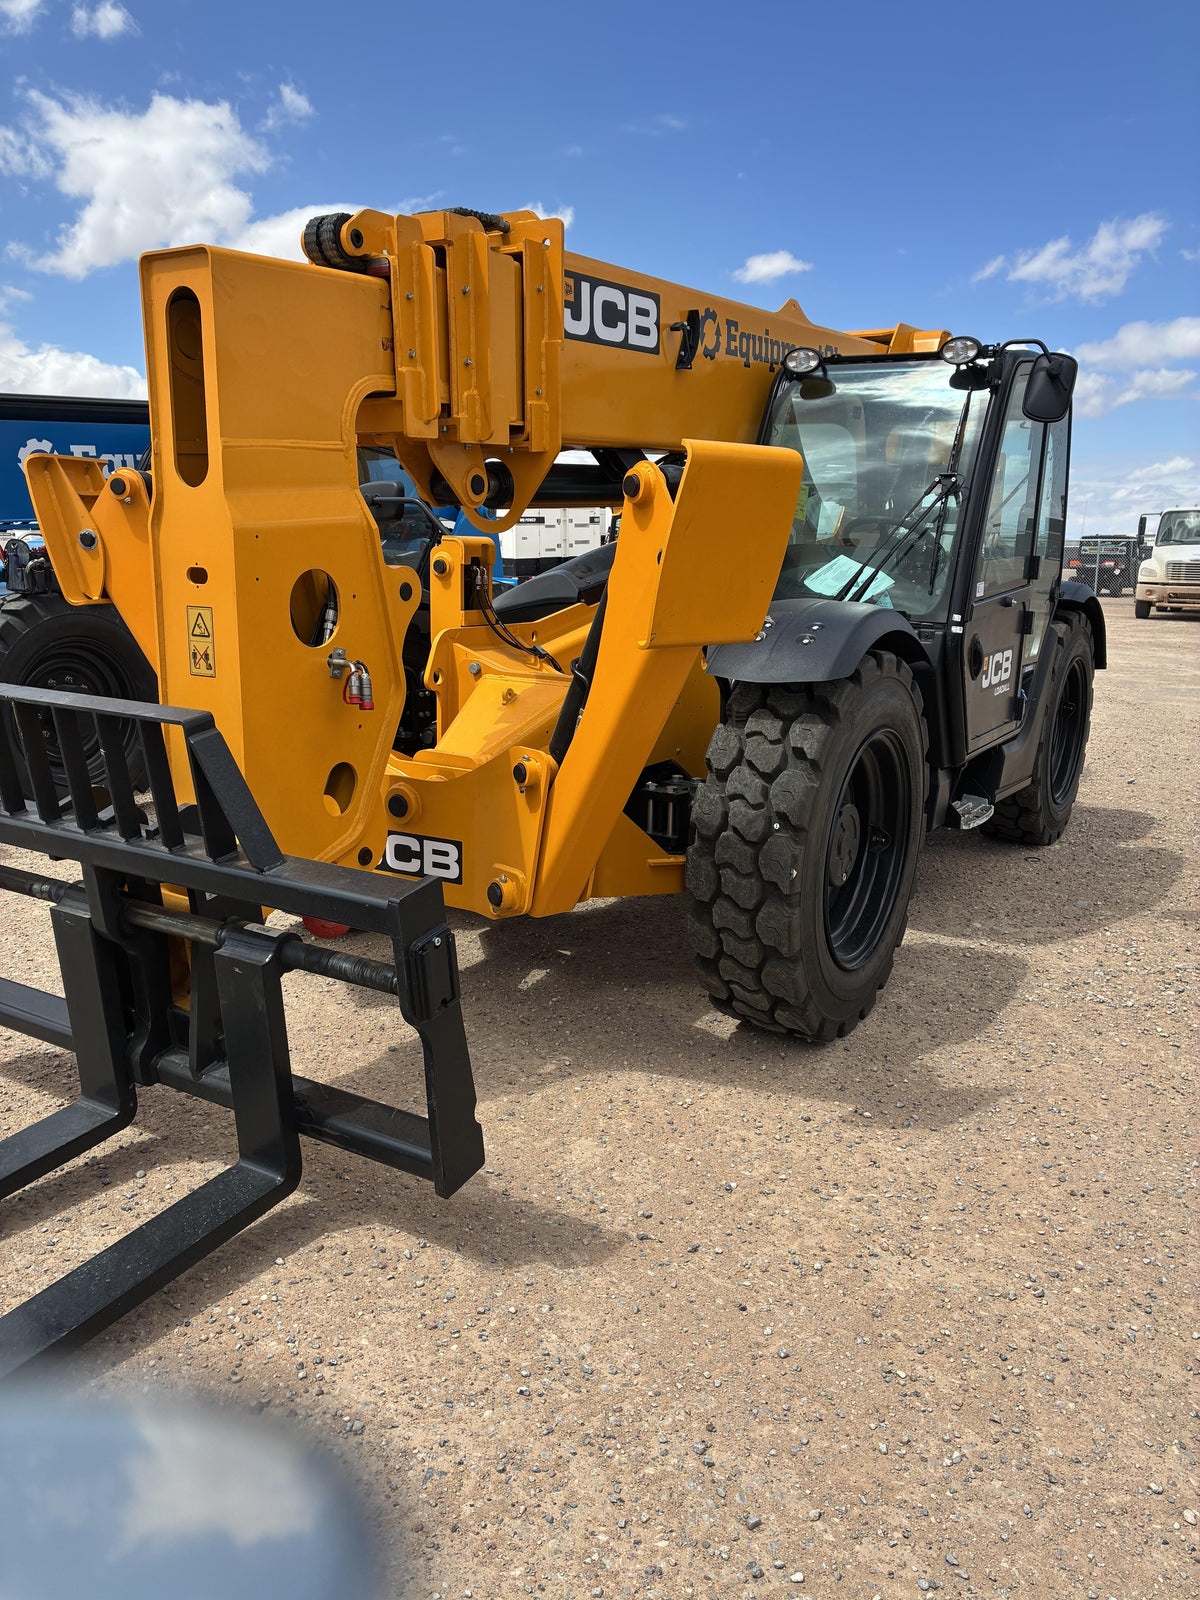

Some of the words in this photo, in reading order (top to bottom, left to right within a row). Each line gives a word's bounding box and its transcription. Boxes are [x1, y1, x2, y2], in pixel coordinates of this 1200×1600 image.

[564, 280, 658, 348] JCB
[982, 649, 1013, 689] JCB
[378, 834, 460, 879] CB
